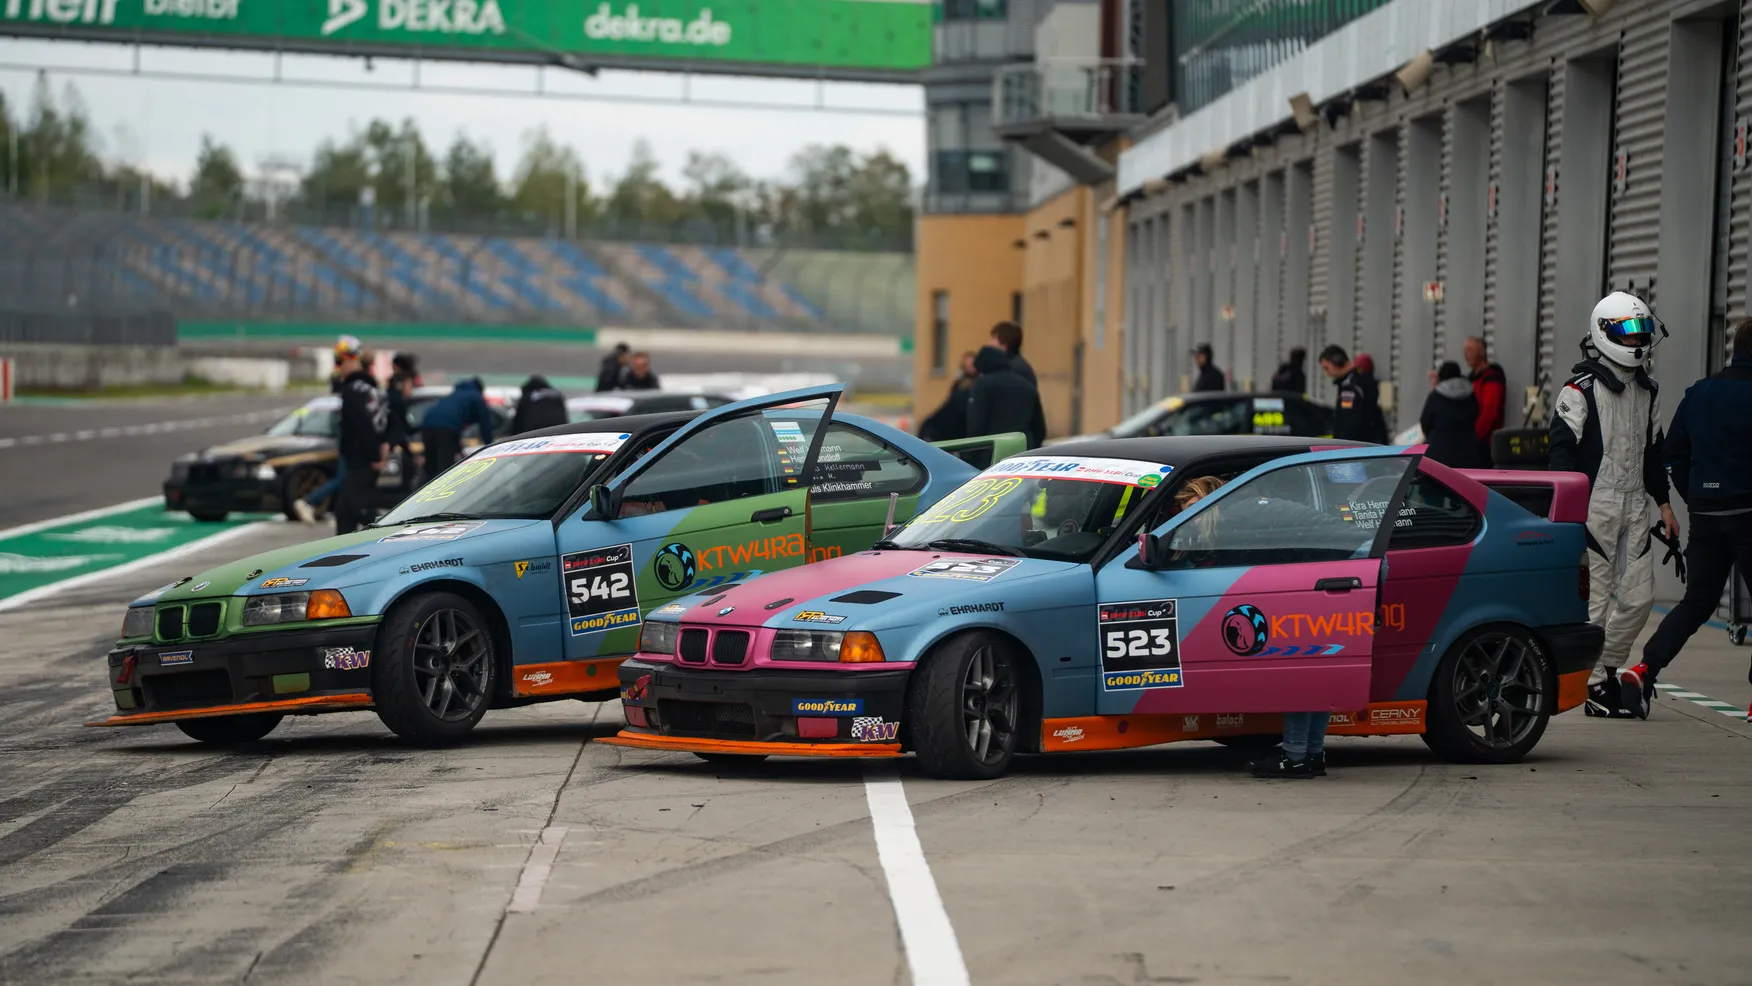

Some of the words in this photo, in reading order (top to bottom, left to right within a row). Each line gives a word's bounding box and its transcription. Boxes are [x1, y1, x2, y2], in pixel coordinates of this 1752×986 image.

[377, 0, 506, 35] DEKRA
[584, 4, 731, 46] dekra.de
[787, 446, 805, 454] Welf
[824, 463, 865, 471] Kellermann
[822, 482, 872, 492] Klinkhammer
[1349, 501, 1367, 511] Kira
[1353, 510, 1378, 520] Tanita
[1356, 520, 1375, 529] Welf
[411, 558, 464, 573] EHRHARDT
[606, 555, 619, 563] Cup
[571, 572, 631, 605] 542
[950, 602, 1004, 615] EHRHARDT
[1148, 610, 1162, 618] Cup
[574, 612, 637, 630] GOODYEAR
[1106, 628, 1172, 659] 523
[161, 654, 189, 662] RAVENOL
[335, 650, 371, 671] KW
[1107, 671, 1179, 686] GOODYEAR
[798, 700, 857, 713] GOODYEAR
[1371, 708, 1421, 719] CERNY
[860, 722, 900, 741] KW
